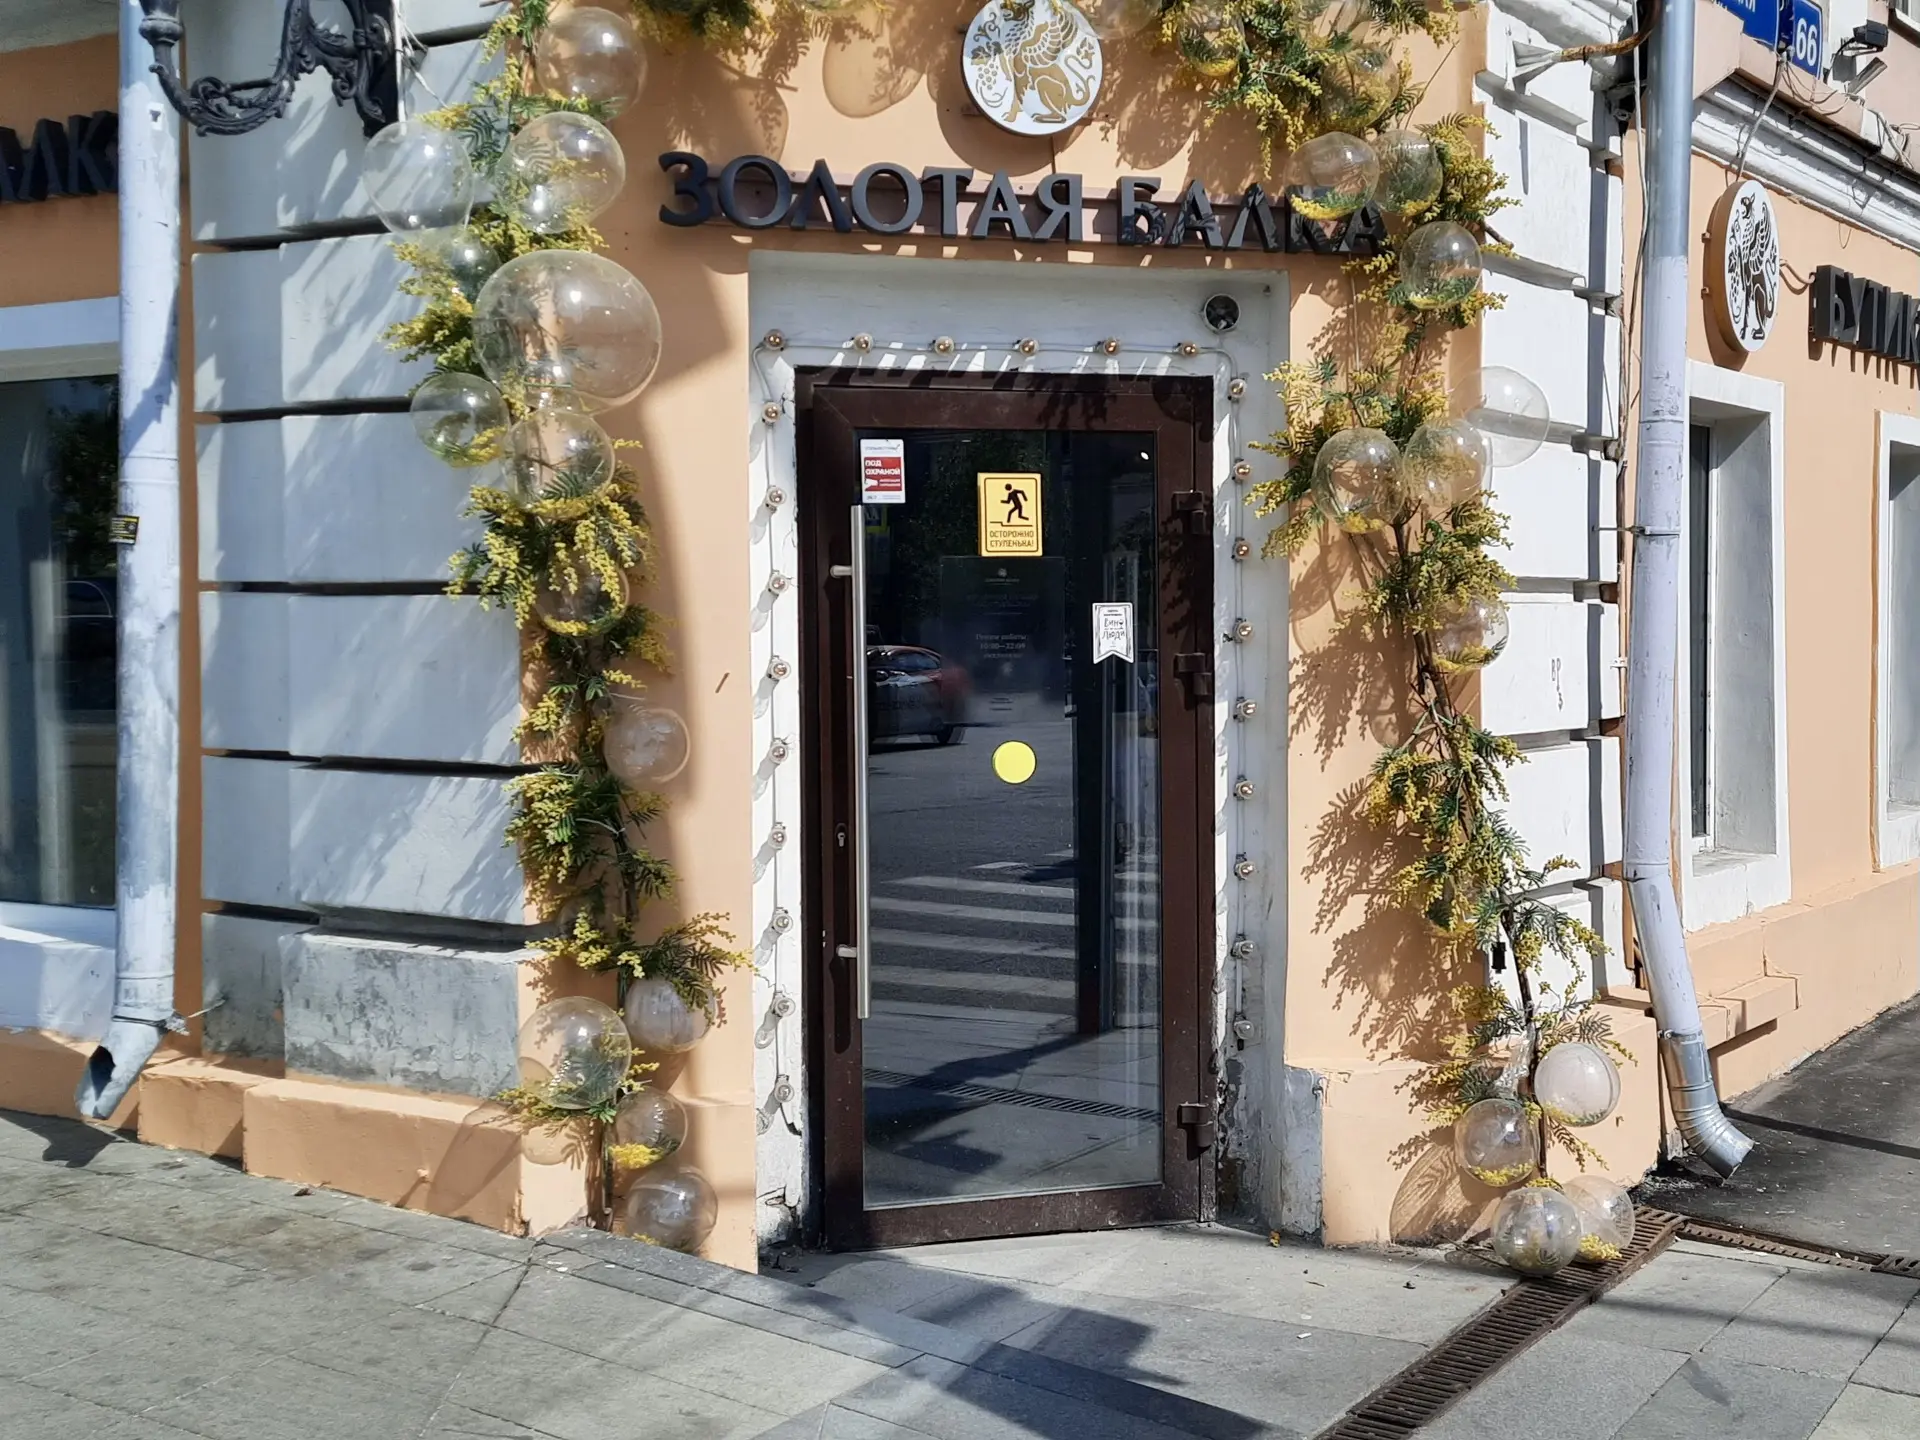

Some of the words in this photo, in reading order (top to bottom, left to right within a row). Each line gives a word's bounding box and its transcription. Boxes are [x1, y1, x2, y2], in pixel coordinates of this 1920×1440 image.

[1796, 17, 1818, 67] 66
[658, 151, 1083, 243] ЗОЛОТАЯ
[1116, 175, 1390, 254] БАЛКА
[865, 459, 882, 468] ПОД
[865, 467, 901, 476] ОХРАНОЙ
[989, 530, 1035, 538] ОСТОРОЖНО
[989, 539, 1035, 548] СТУПЕНЬКА!
